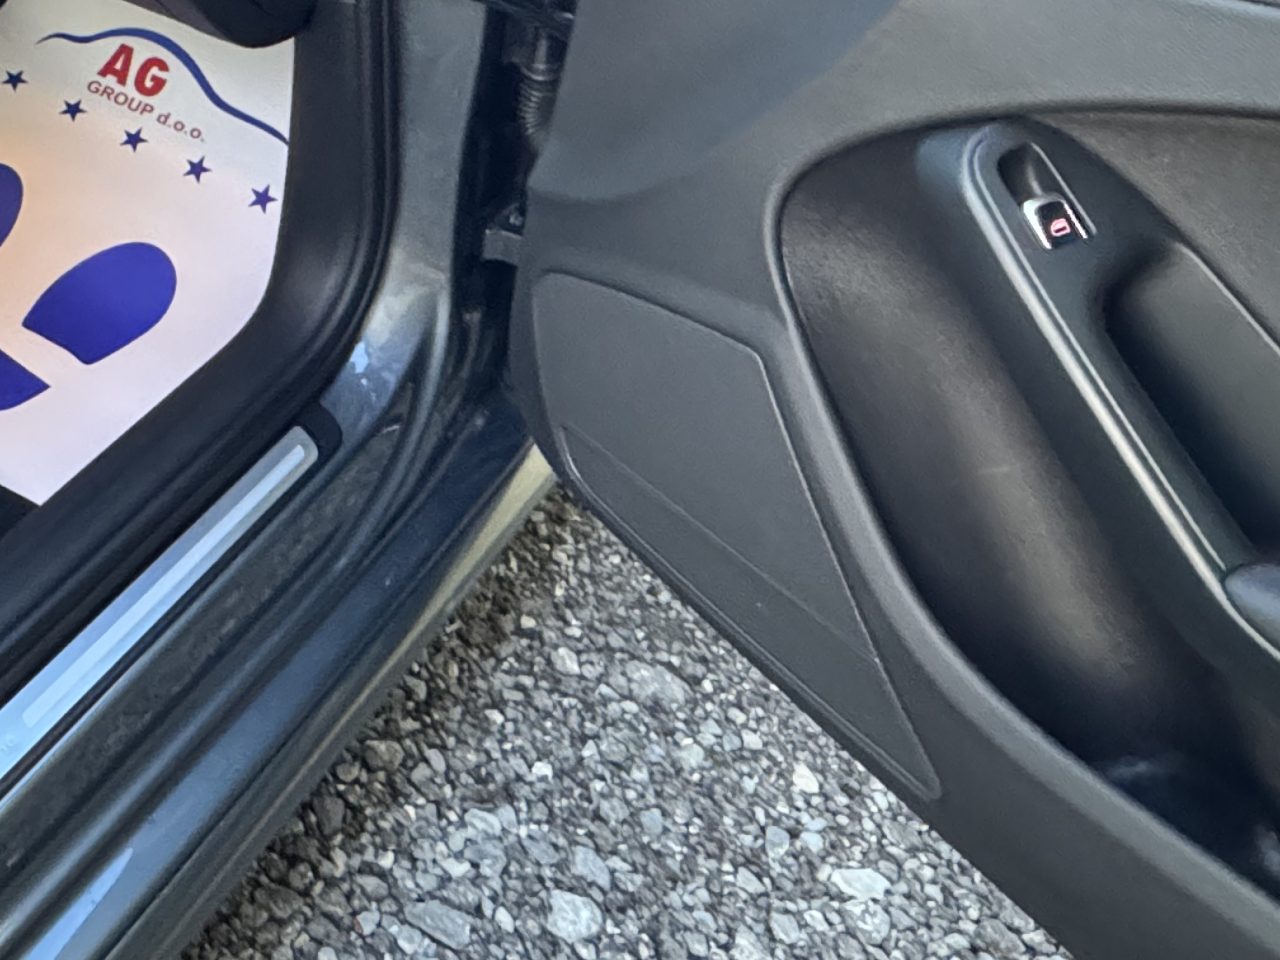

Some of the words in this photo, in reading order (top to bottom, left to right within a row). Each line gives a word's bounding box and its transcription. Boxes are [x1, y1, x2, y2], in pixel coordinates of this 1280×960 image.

[97, 43, 170, 97] AG
[86, 80, 154, 116] GROUP
[156, 112, 205, 142] d.o.o.
